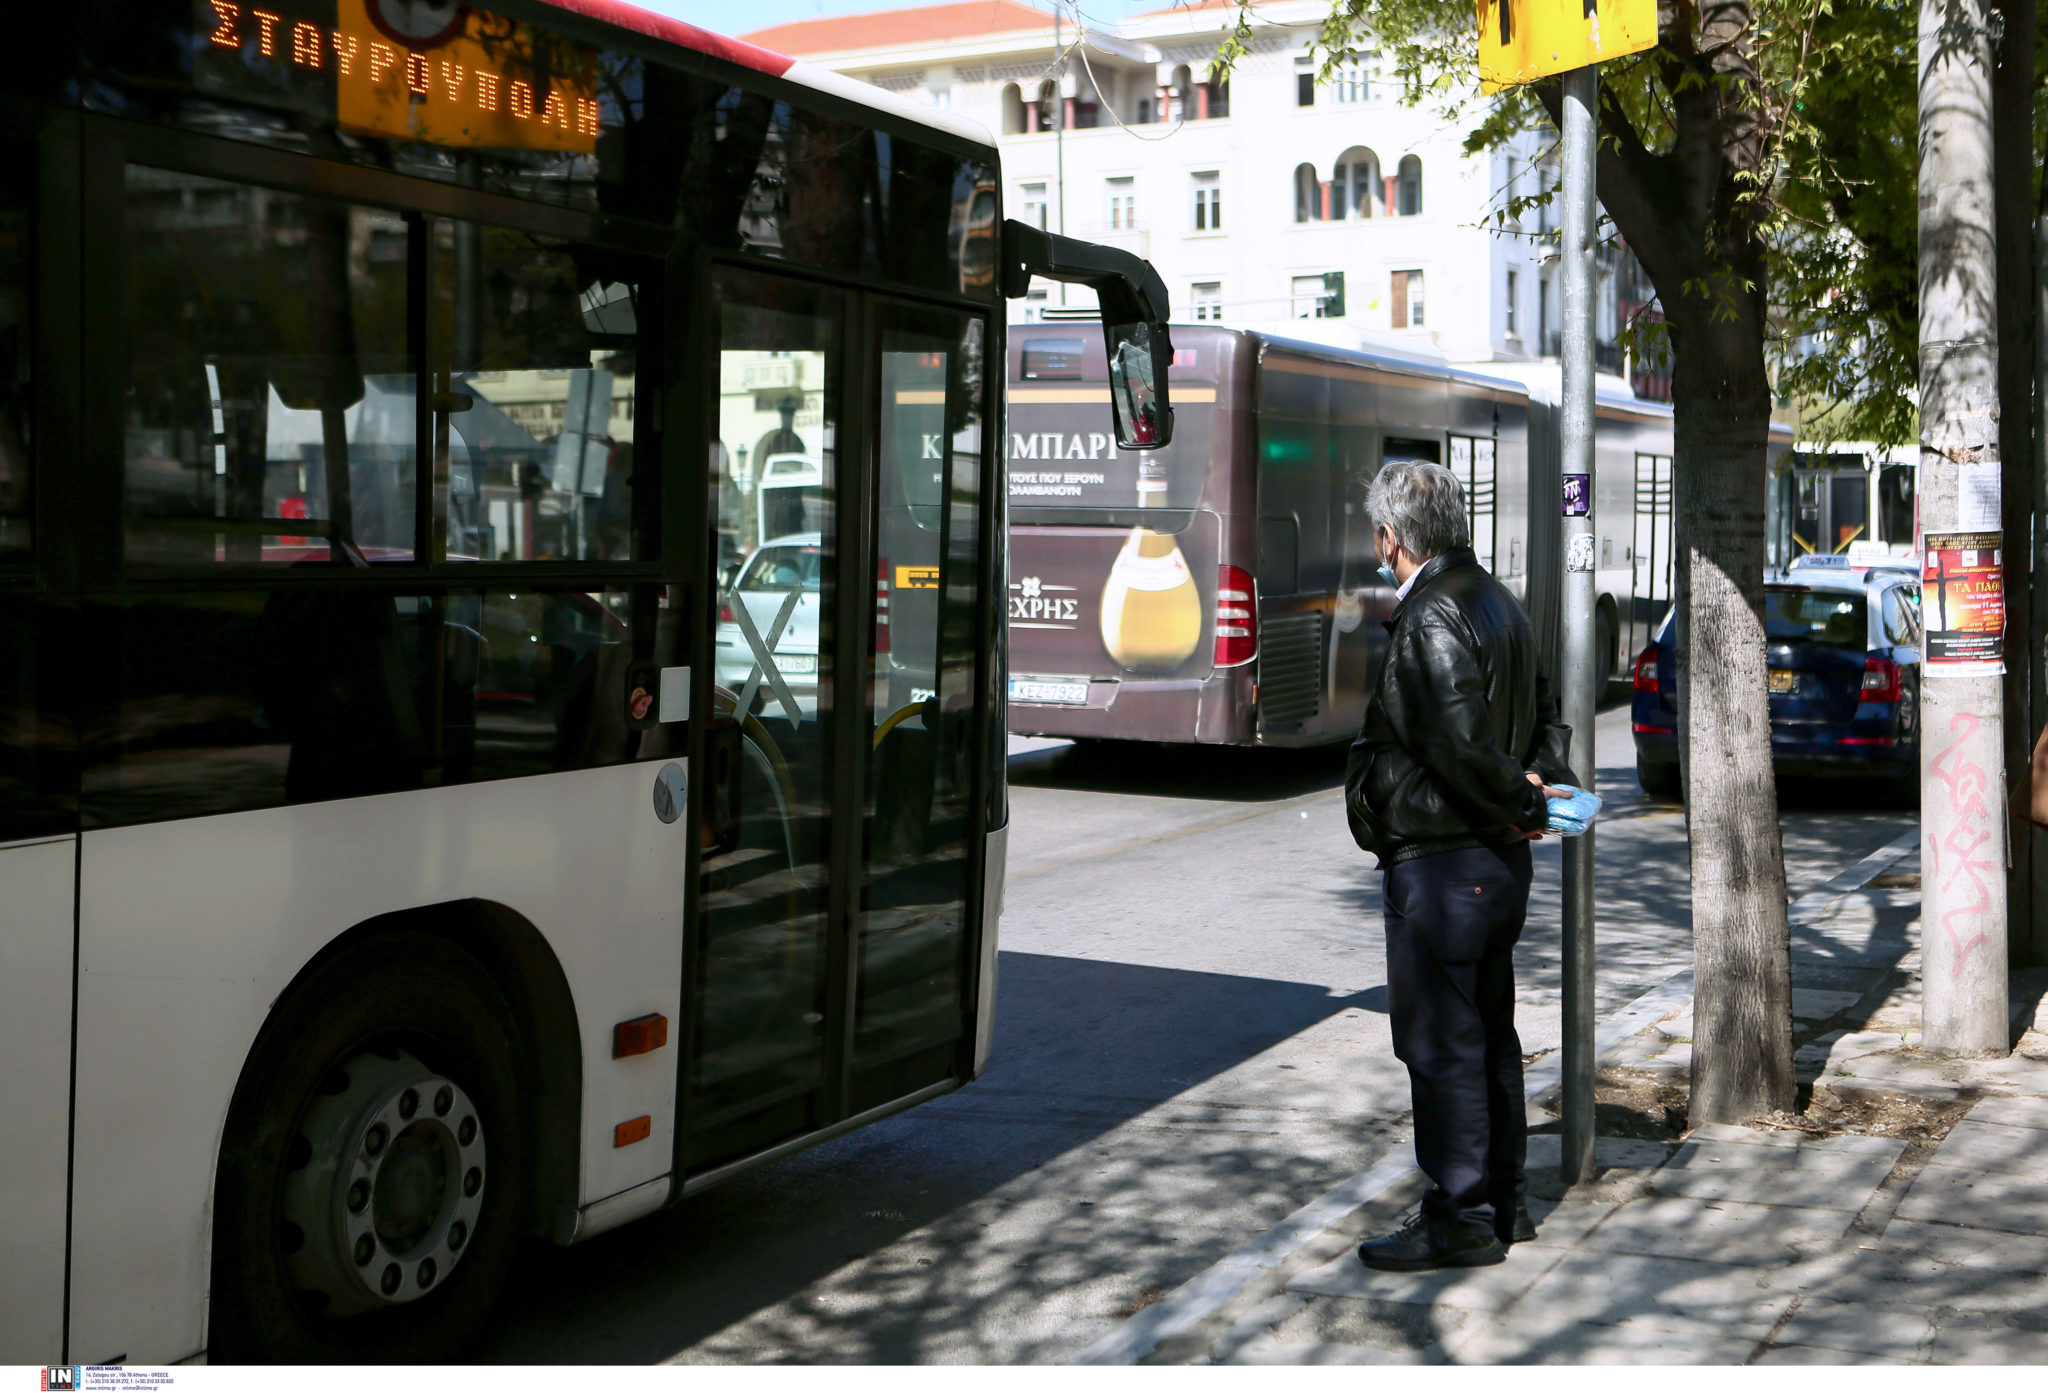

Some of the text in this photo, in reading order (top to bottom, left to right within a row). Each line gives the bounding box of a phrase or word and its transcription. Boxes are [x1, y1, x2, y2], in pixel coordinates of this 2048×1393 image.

[210, 0, 599, 137] ΣΤΑΥΡΟΥΠΟΛΗ
[1039, 472, 1062, 483] ΠΟΥ
[1009, 597, 1079, 620] ΕΧΡΗΣ
